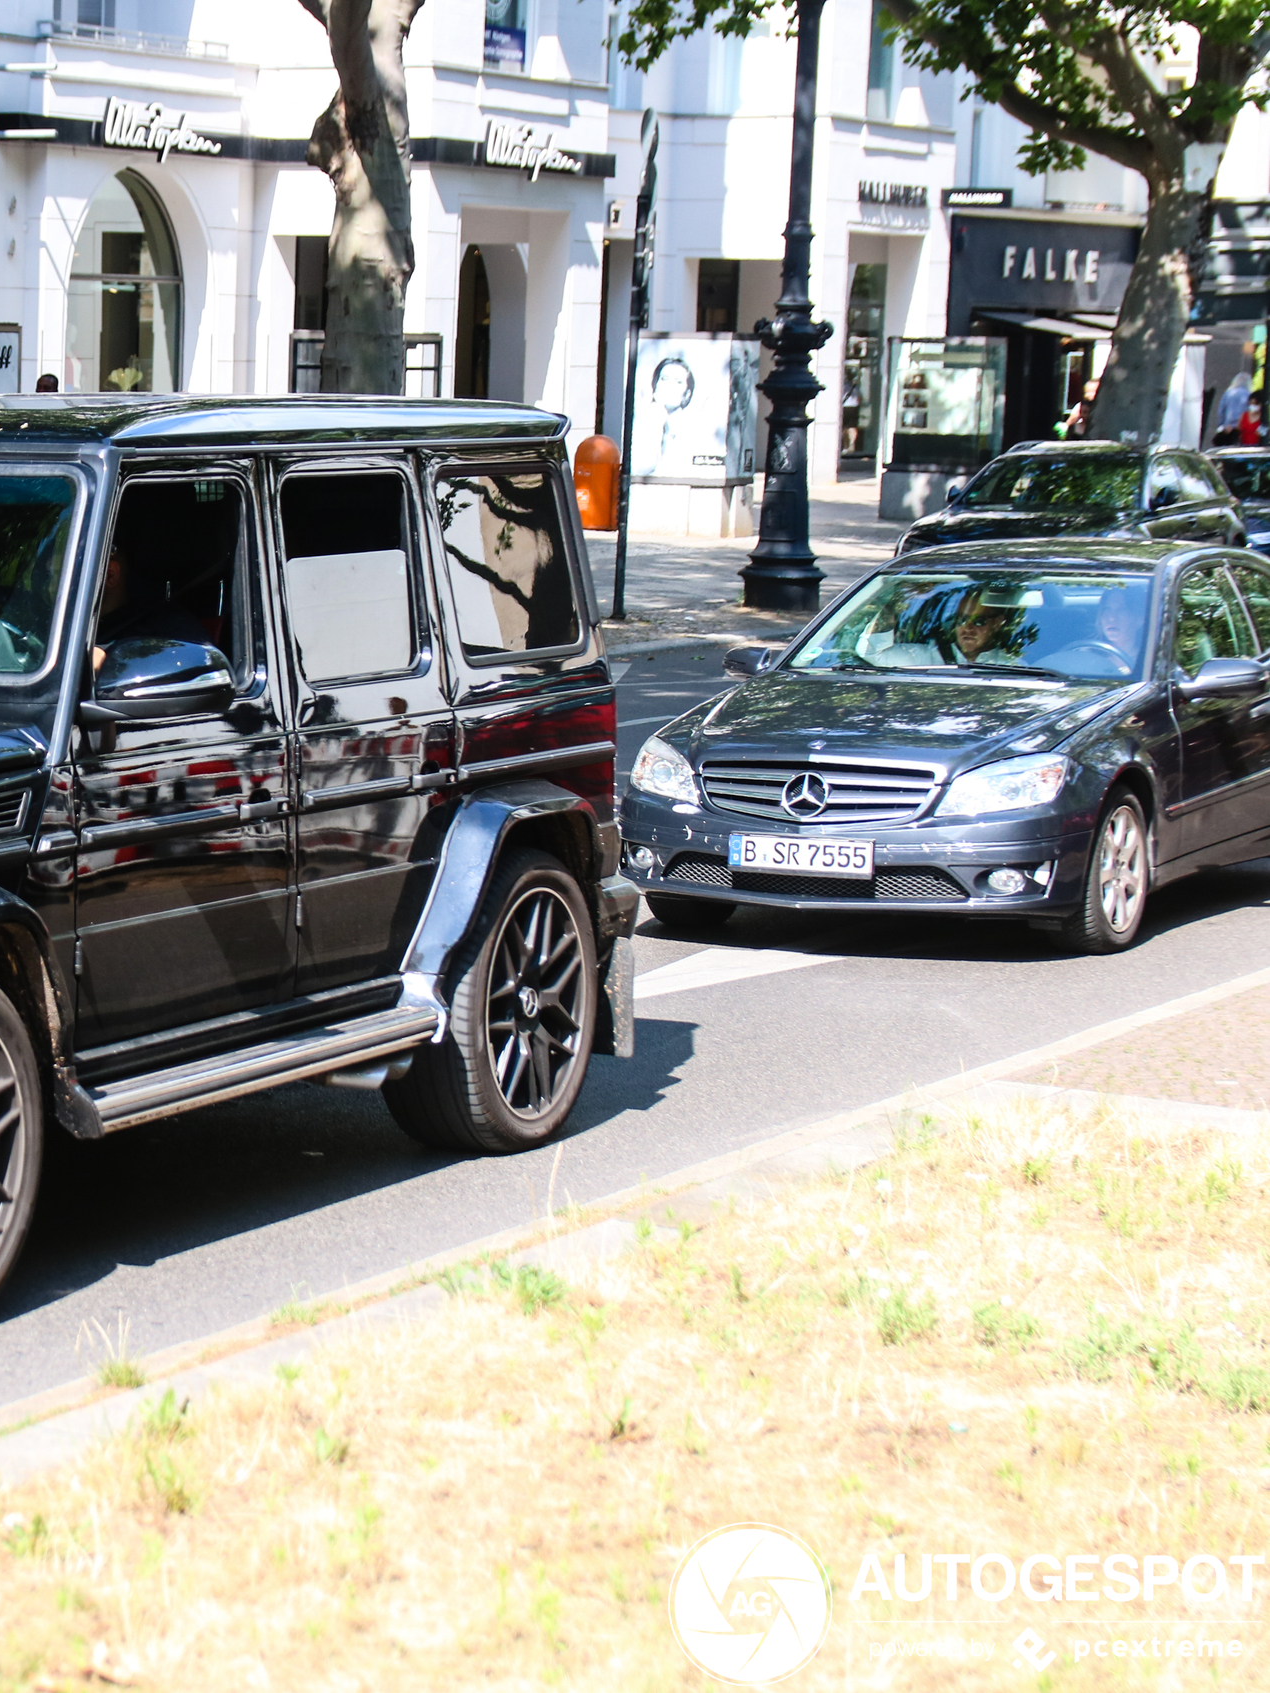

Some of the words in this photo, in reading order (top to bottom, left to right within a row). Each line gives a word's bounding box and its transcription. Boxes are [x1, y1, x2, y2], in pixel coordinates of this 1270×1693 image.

[1002, 245, 1100, 283] FALKE
[744, 840, 756, 862] B
[773, 842, 800, 866] SR
[808, 844, 866, 868] 7555
